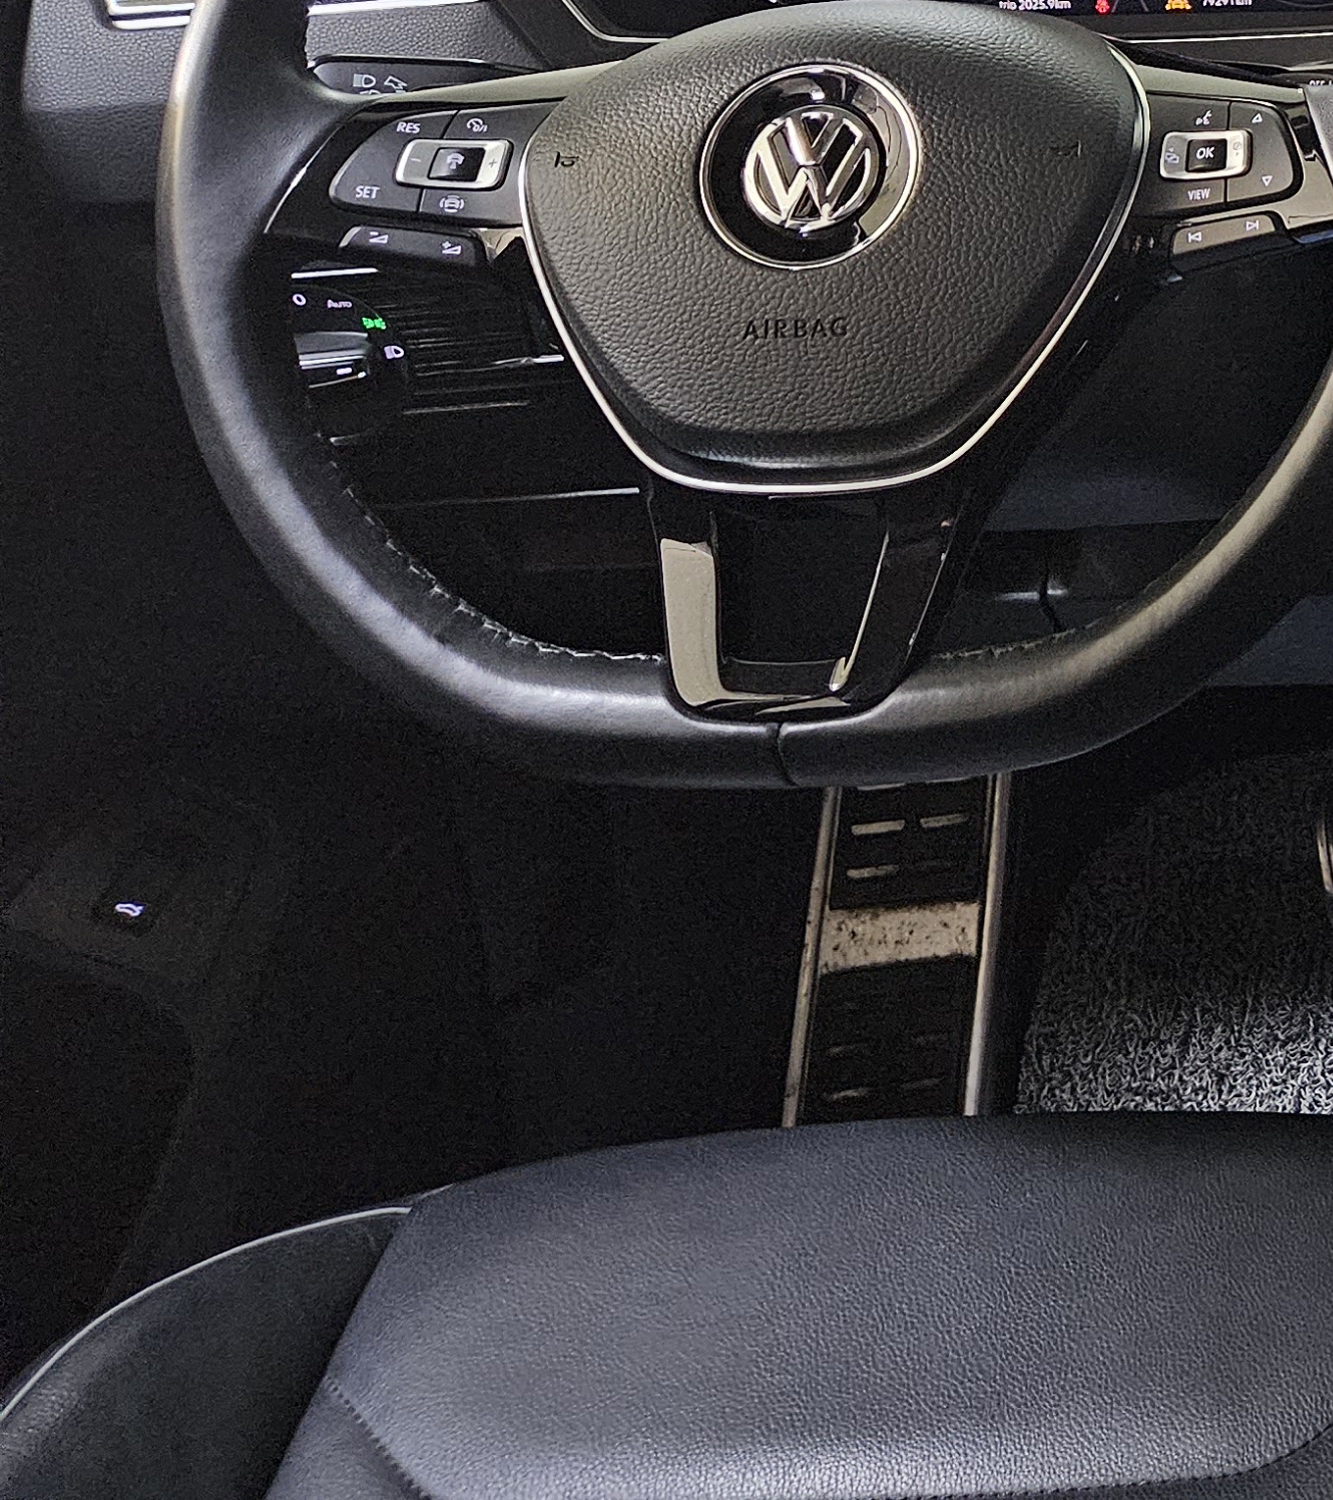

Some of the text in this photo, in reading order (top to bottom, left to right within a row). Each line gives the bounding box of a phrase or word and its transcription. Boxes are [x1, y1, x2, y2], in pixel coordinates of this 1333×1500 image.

[396, 122, 421, 134] RES
[1195, 147, 1215, 159] OK
[355, 185, 380, 199] SET
[1187, 188, 1211, 201] VIEW
[743, 316, 849, 341] AIRBAG
